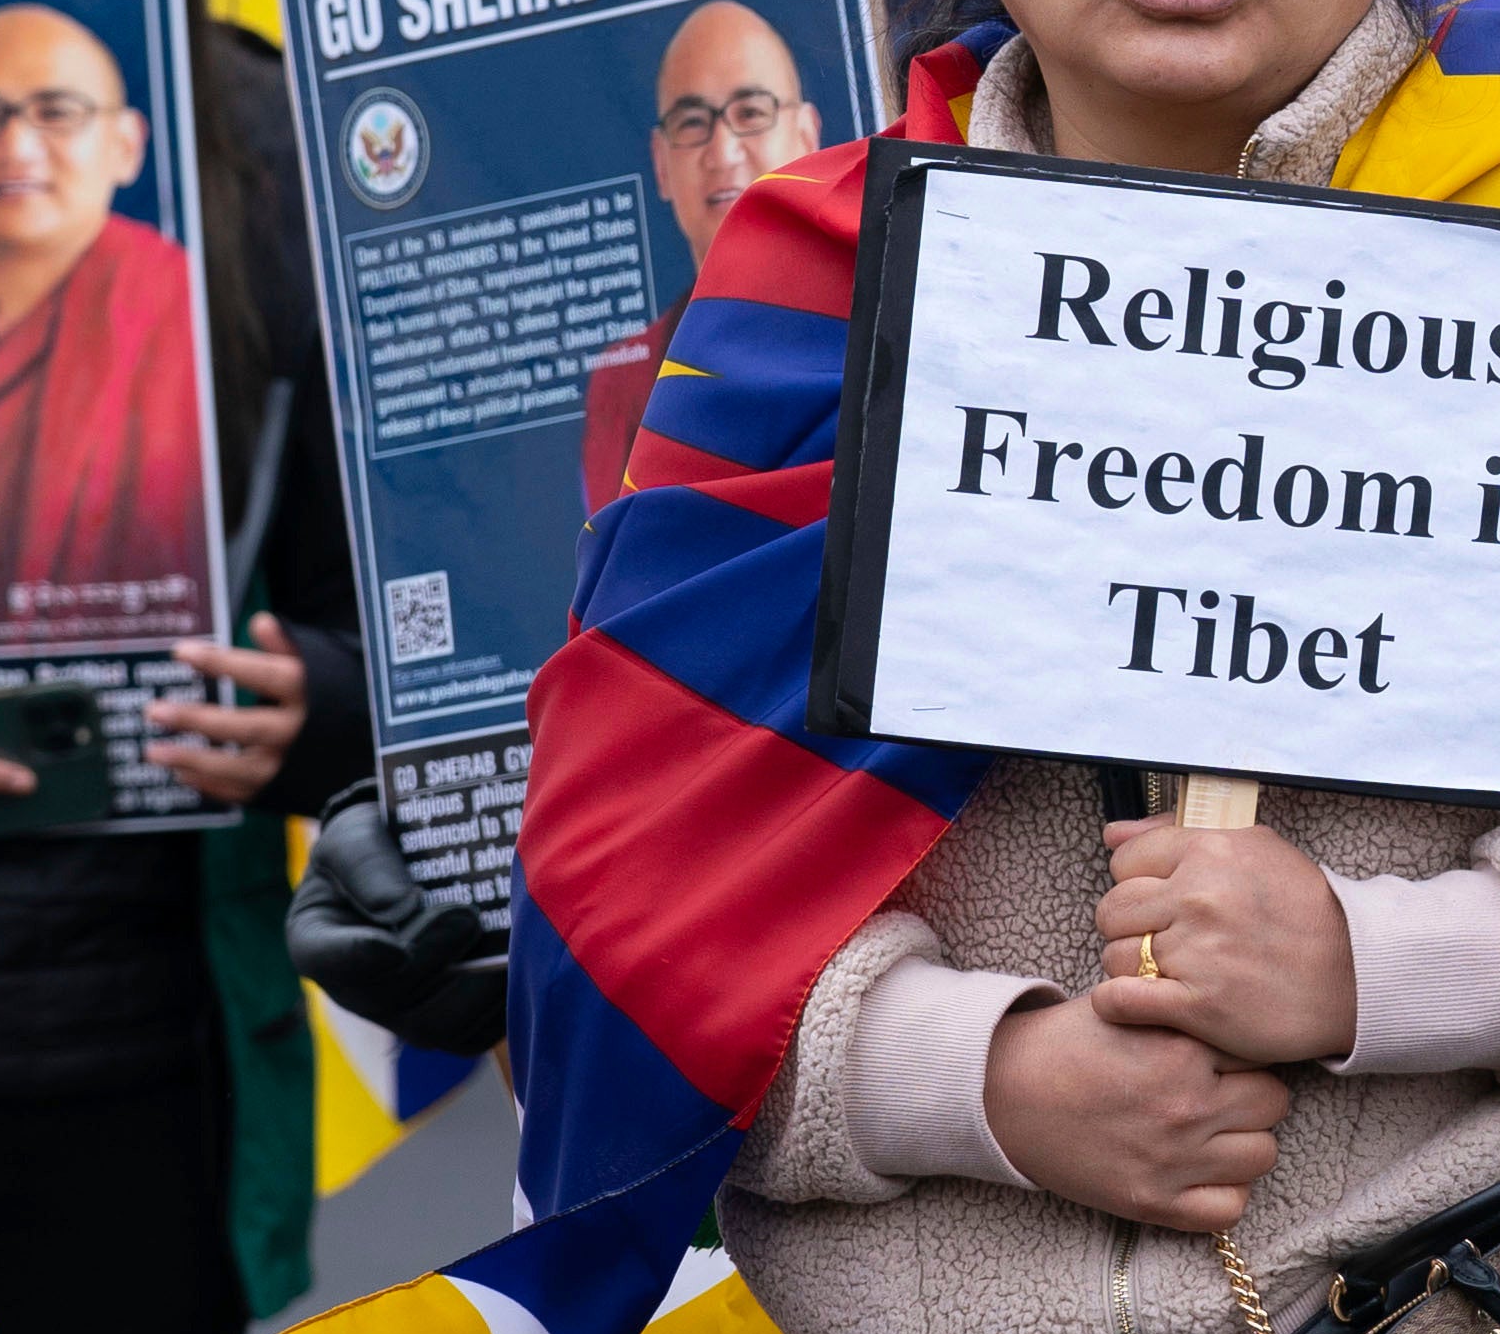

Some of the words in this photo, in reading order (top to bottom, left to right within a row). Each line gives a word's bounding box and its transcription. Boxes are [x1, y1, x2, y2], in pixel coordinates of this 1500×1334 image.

[355, 246, 381, 267] One
[384, 239, 400, 262] of
[402, 236, 424, 257] the
[449, 215, 516, 247] individuals
[519, 198, 590, 233] considered
[593, 196, 609, 216] to
[613, 191, 633, 212] be
[358, 261, 422, 291] POLITICAL
[424, 243, 498, 277] PRISONERS
[501, 241, 518, 264] by
[521, 235, 544, 258] the
[546, 223, 590, 252] United
[592, 218, 636, 242] States
[361, 285, 431, 318] Department
[433, 281, 446, 301] of
[482, 256, 552, 290] imprisoned
[552, 255, 572, 276] for
[573, 242, 639, 272] exercising
[366, 320, 395, 342] their
[395, 310, 437, 335] human
[478, 295, 509, 318] They
[510, 281, 565, 312] highlight
[564, 277, 588, 299] the
[588, 268, 642, 297] growing
[370, 334, 444, 366] authoritarian
[448, 324, 490, 349] efforts
[493, 318, 509, 340] to
[514, 311, 559, 336] silence
[617, 289, 645, 314] and
[372, 364, 428, 391] suppress
[427, 346, 501, 379] fundamental
[561, 324, 605, 351] United
[604, 318, 647, 342] States
[375, 381, 448, 419] government
[449, 381, 464, 400] is
[465, 367, 532, 398] advocating
[533, 361, 553, 382] for
[555, 357, 580, 378] the
[580, 342, 650, 373] immediate
[377, 415, 424, 439] release
[425, 407, 440, 430] of
[439, 405, 473, 428] these
[472, 390, 521, 425] political
[946, 403, 1433, 540] Freedom
[1107, 581, 1397, 695] Tibet
[395, 668, 536, 708] www.gosherabgyatso
[392, 764, 418, 794] GO
[424, 750, 497, 787] SHERAB
[503, 742, 533, 774] GY
[397, 791, 465, 828] religious
[471, 779, 528, 815] philos
[400, 815, 480, 854] sentenced
[481, 813, 500, 839] to
[409, 847, 471, 883] eaceful
[472, 879, 496, 903] us
